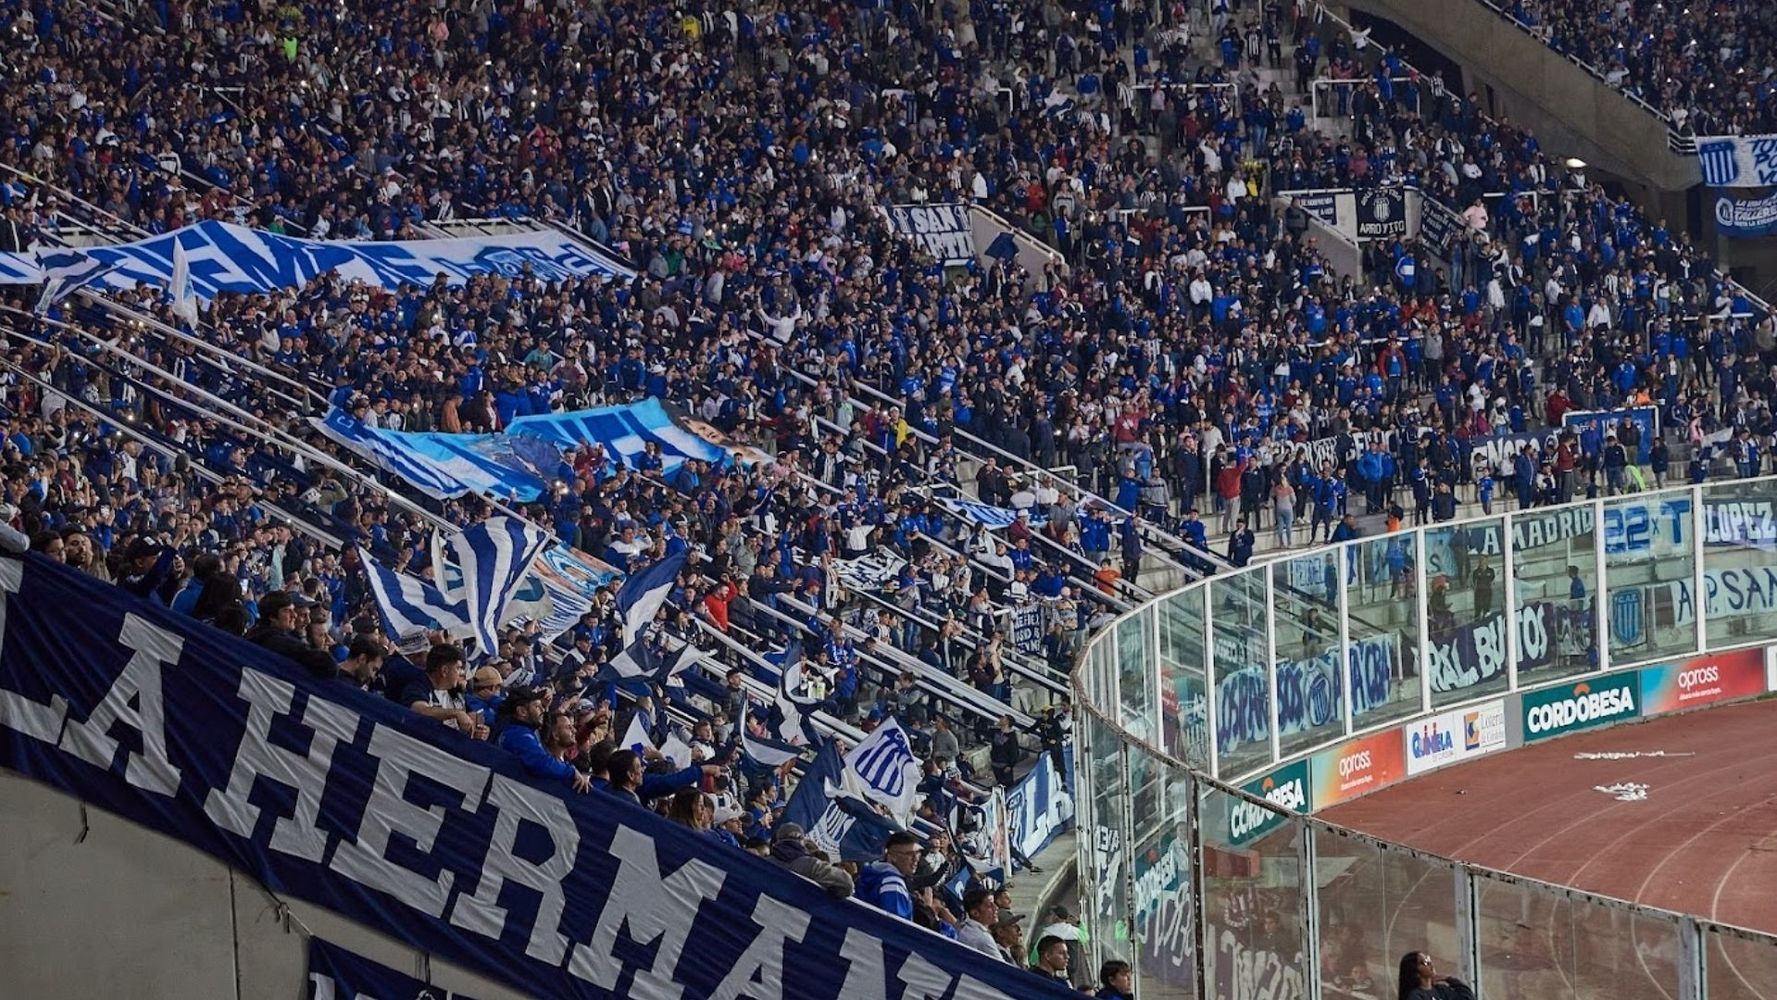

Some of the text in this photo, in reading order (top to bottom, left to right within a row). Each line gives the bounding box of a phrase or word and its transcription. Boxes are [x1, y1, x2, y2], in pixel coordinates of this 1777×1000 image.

[911, 207, 958, 233] SAN
[1473, 604, 1548, 679] BUTOS
[1528, 686, 1635, 733] CORDOBESA
